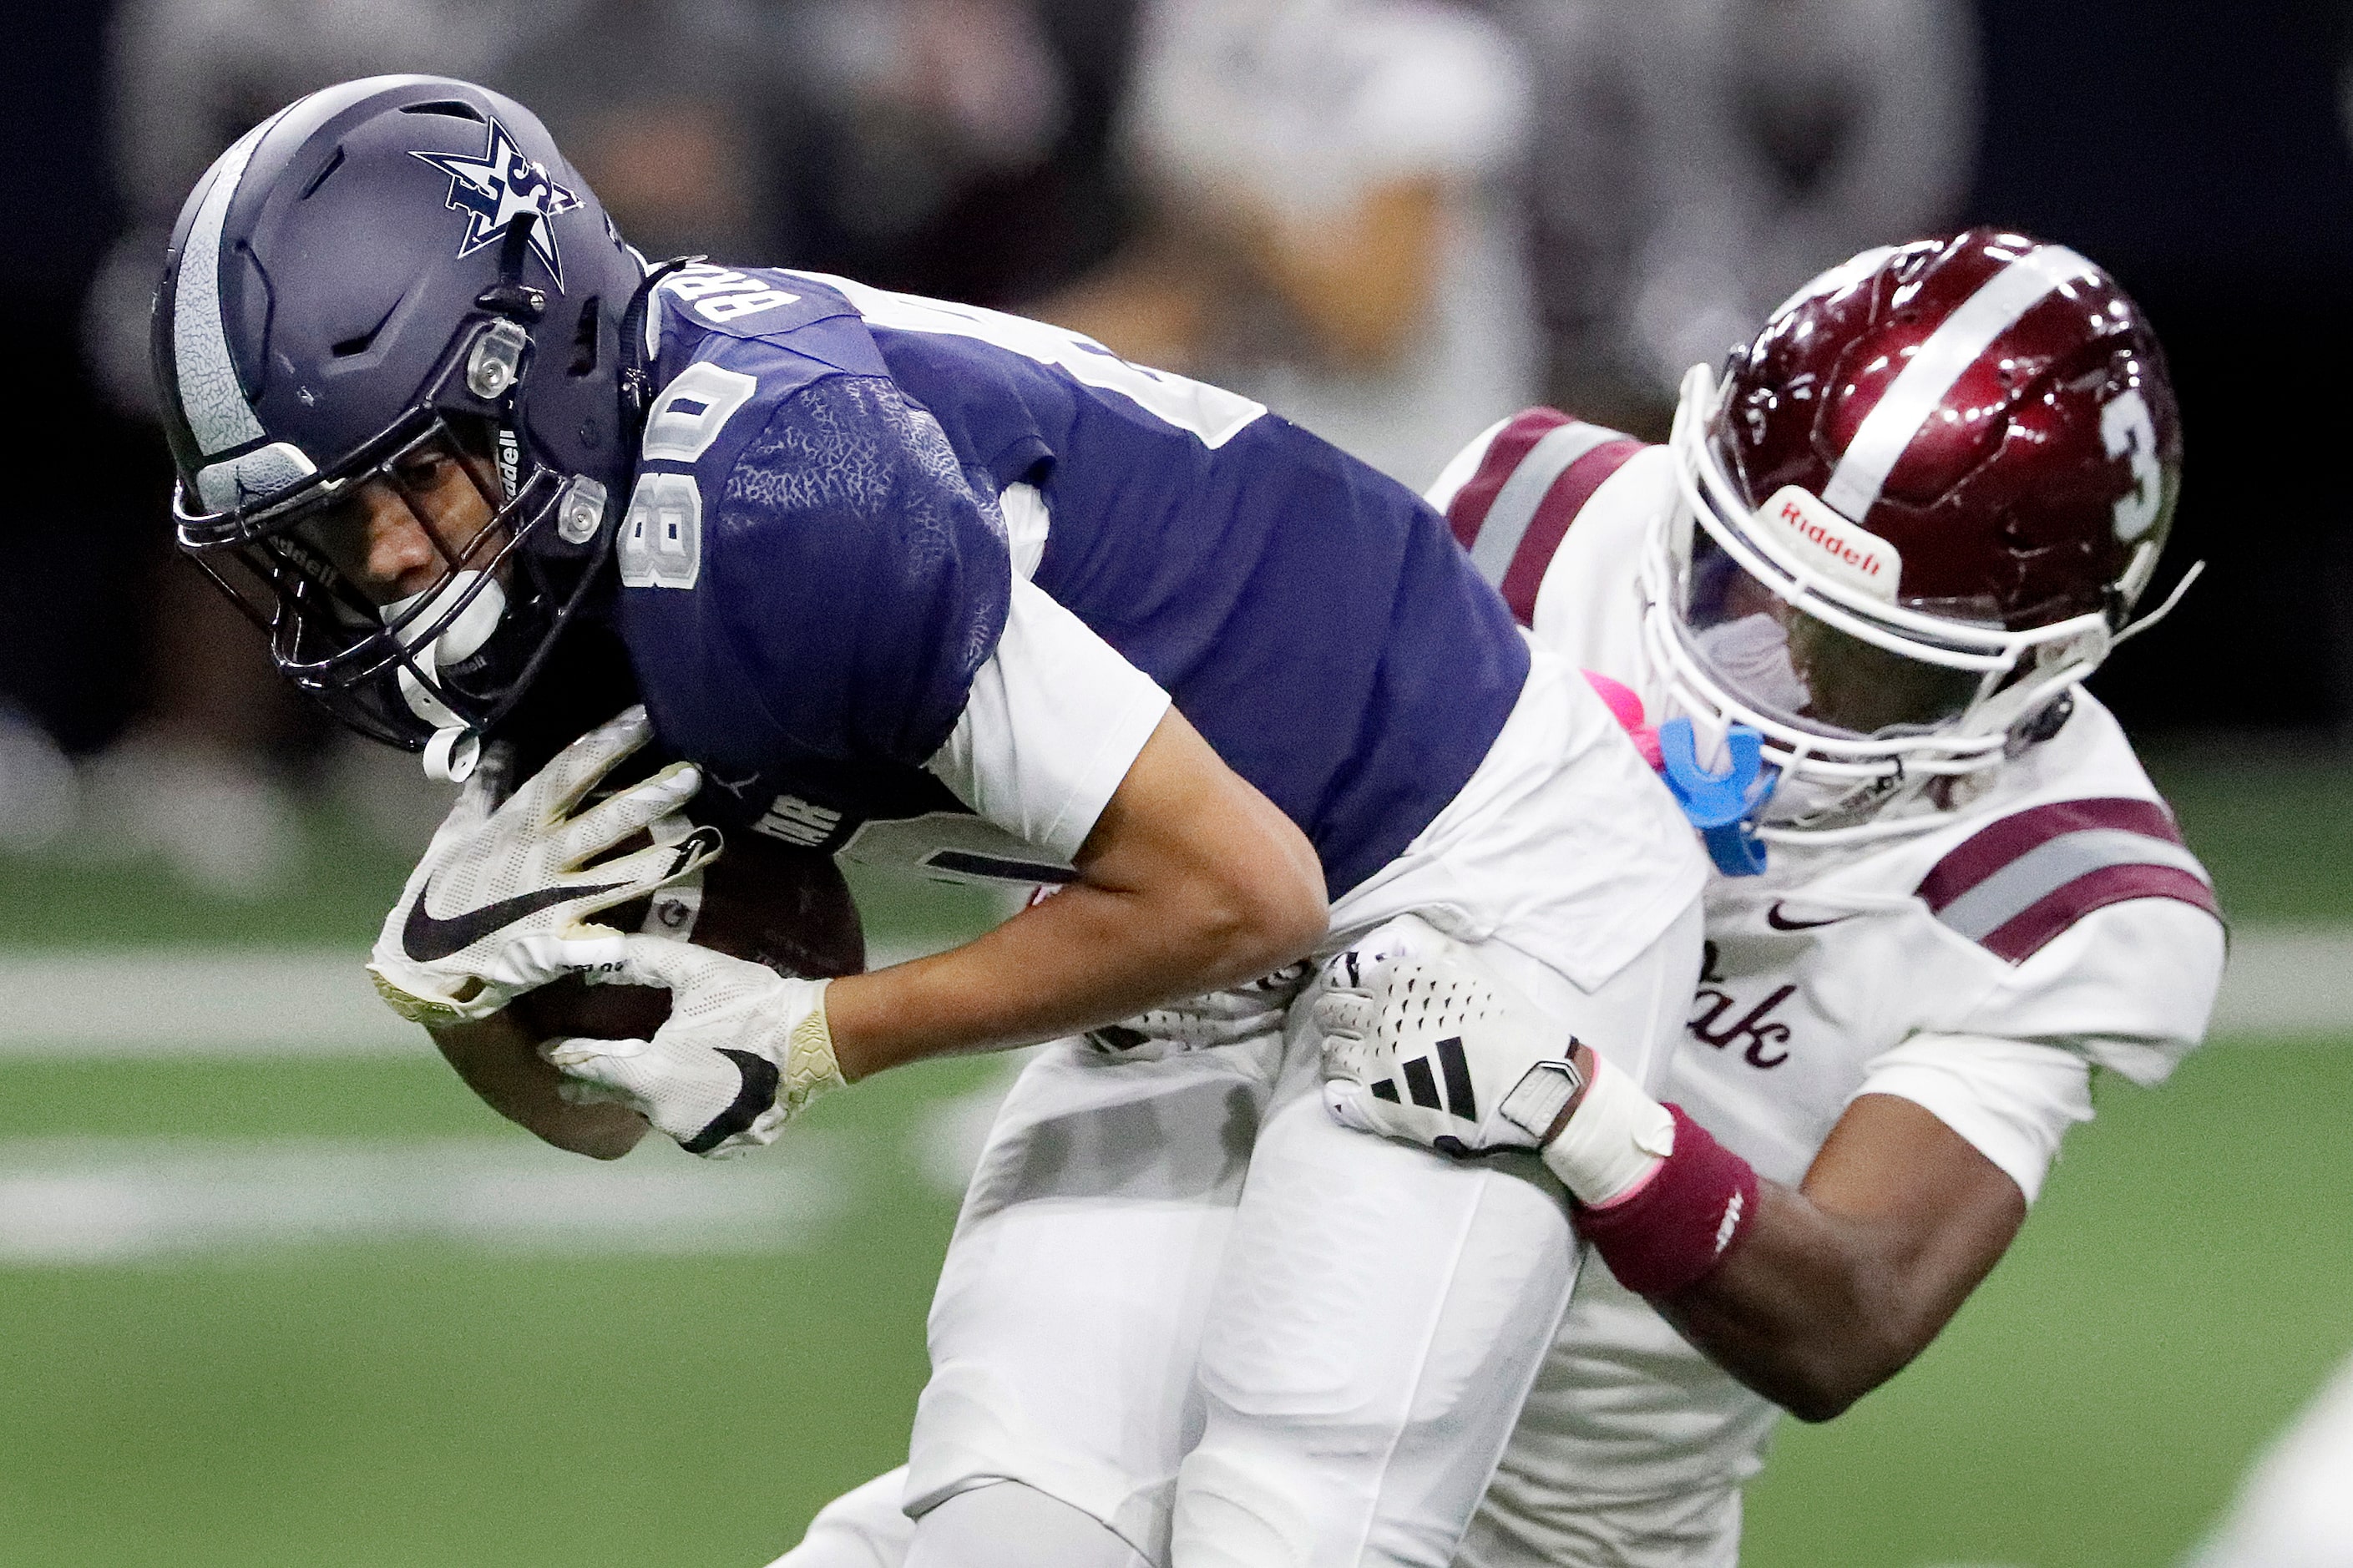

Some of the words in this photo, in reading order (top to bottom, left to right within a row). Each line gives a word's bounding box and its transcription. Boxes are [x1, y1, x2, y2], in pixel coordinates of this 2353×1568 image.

[498, 430, 519, 501] ddell
[616, 361, 757, 589] 80
[2100, 388, 2161, 541] 3
[1781, 502, 1880, 575] Riddell
[1686, 984, 1797, 1068] ak
